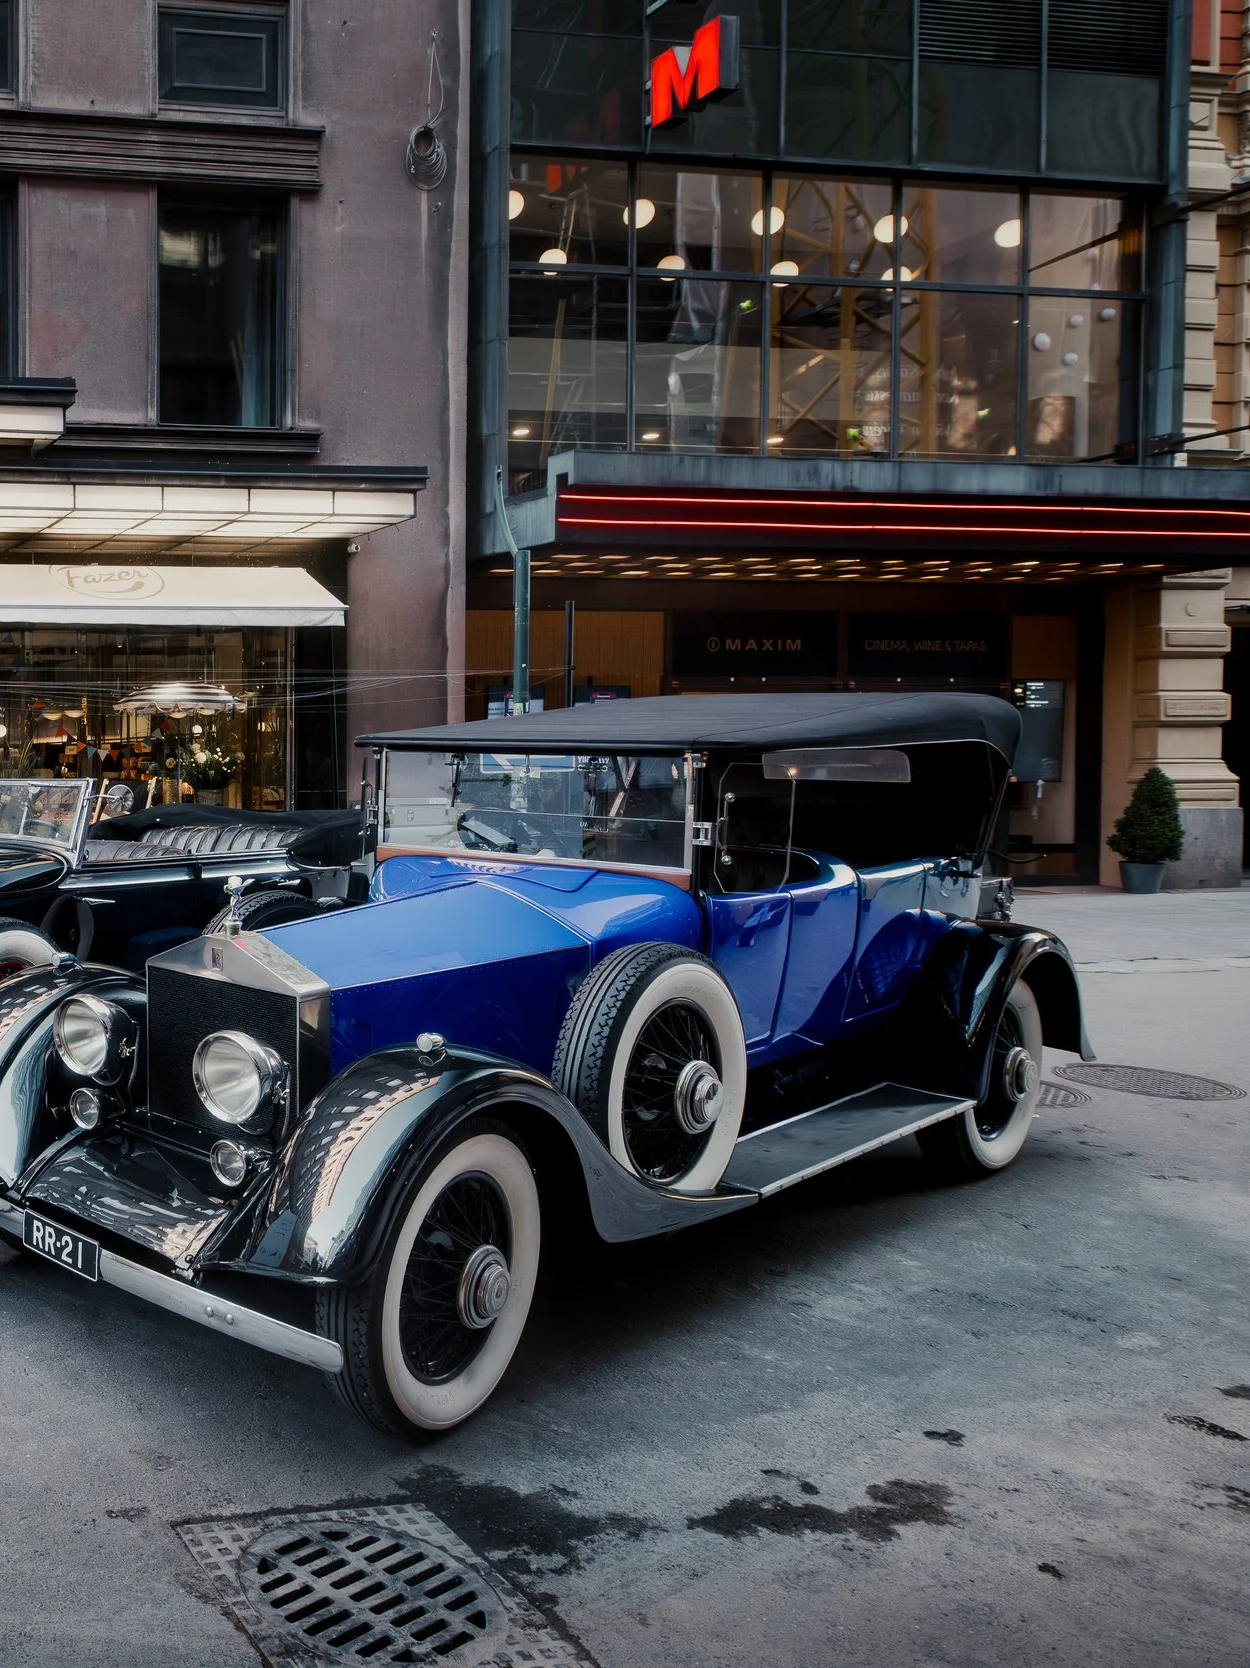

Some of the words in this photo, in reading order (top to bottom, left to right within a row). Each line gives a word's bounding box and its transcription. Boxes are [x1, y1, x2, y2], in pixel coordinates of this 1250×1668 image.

[652, 16, 722, 128] M
[57, 566, 148, 588] Fazer
[725, 639, 802, 651] MAXIM
[864, 639, 911, 652] CINEMA,
[913, 639, 942, 651] WINE
[944, 640, 951, 651] &
[954, 640, 987, 652] TAPAS
[32, 1219, 83, 1269] RR-21
